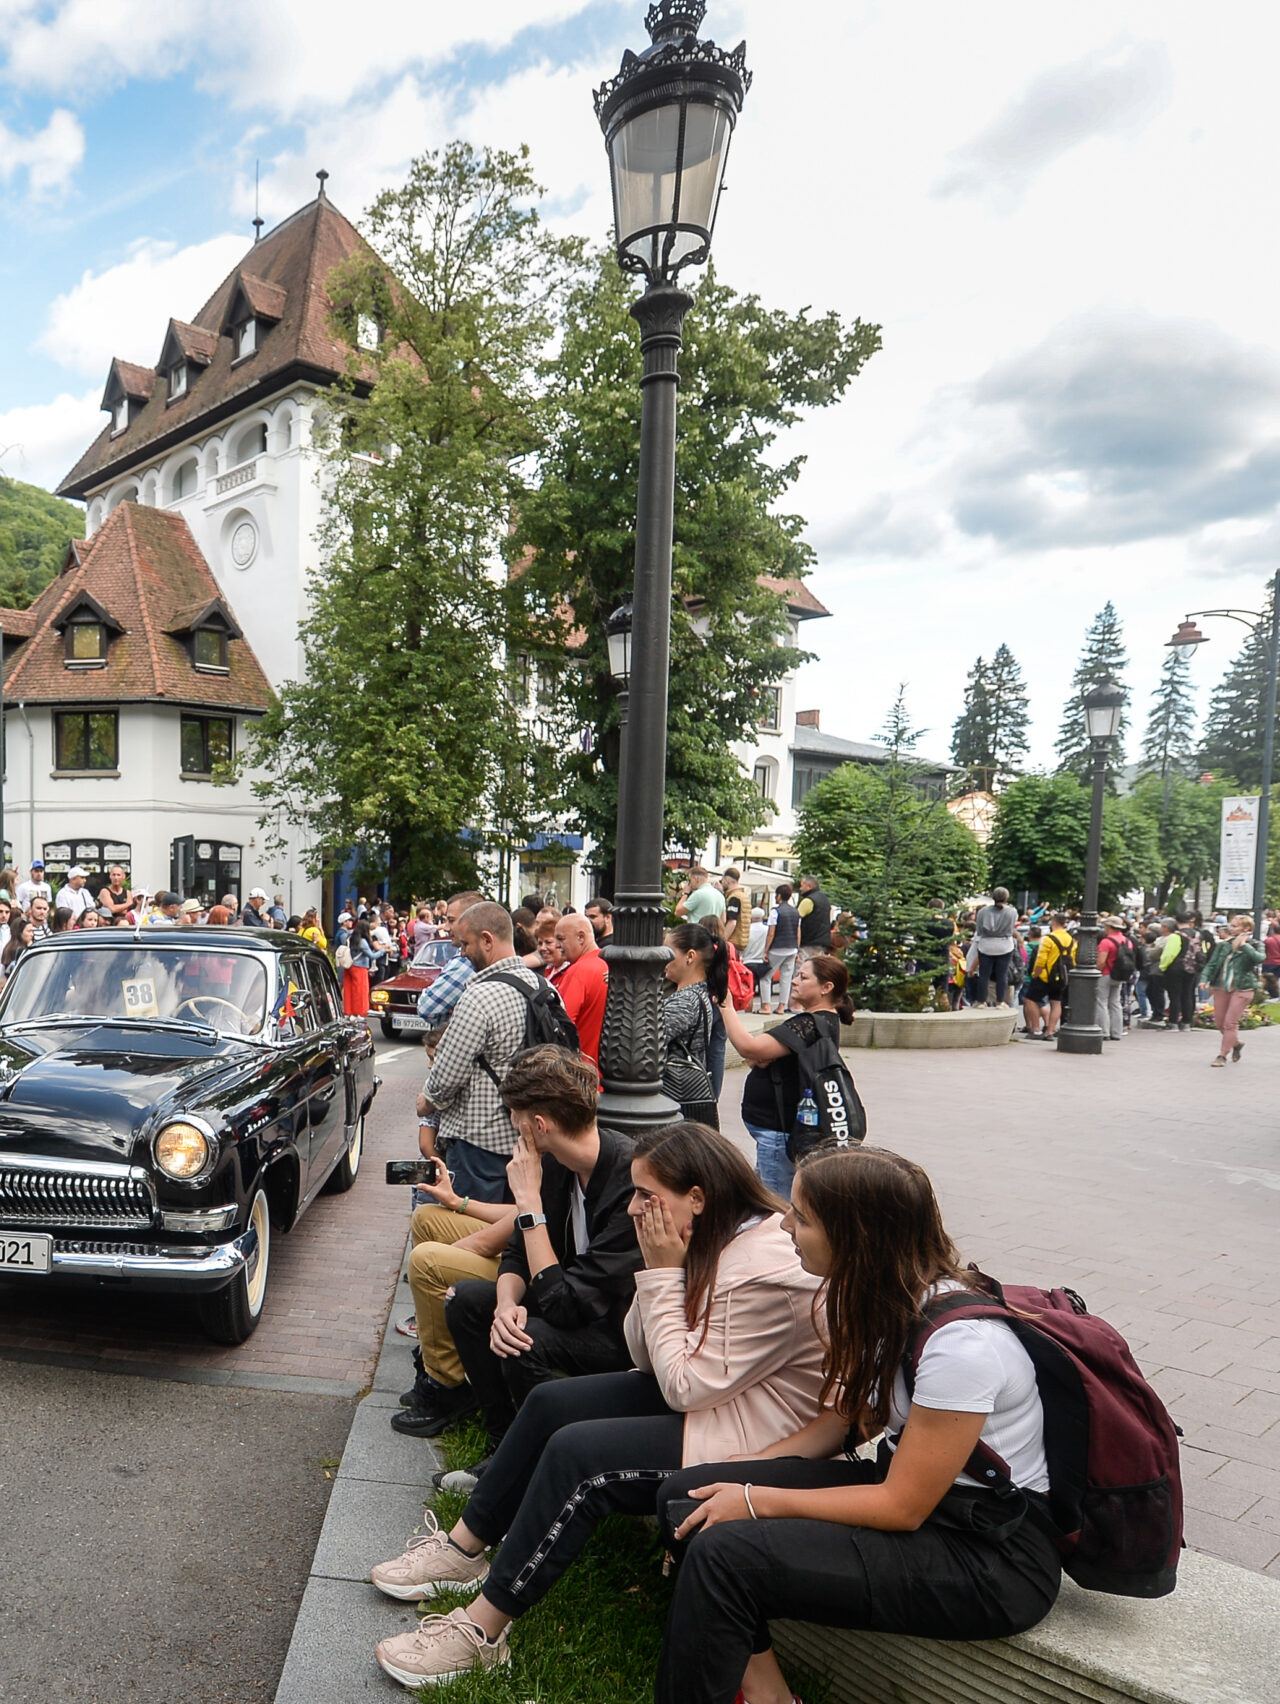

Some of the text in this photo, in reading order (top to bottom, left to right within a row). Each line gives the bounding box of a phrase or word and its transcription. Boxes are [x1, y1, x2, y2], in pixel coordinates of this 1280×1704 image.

[126, 983, 154, 1006] 38
[619, 1471, 640, 1479] NIKE
[548, 1521, 563, 1542] NIKE
[528, 1551, 544, 1570] NIKE
